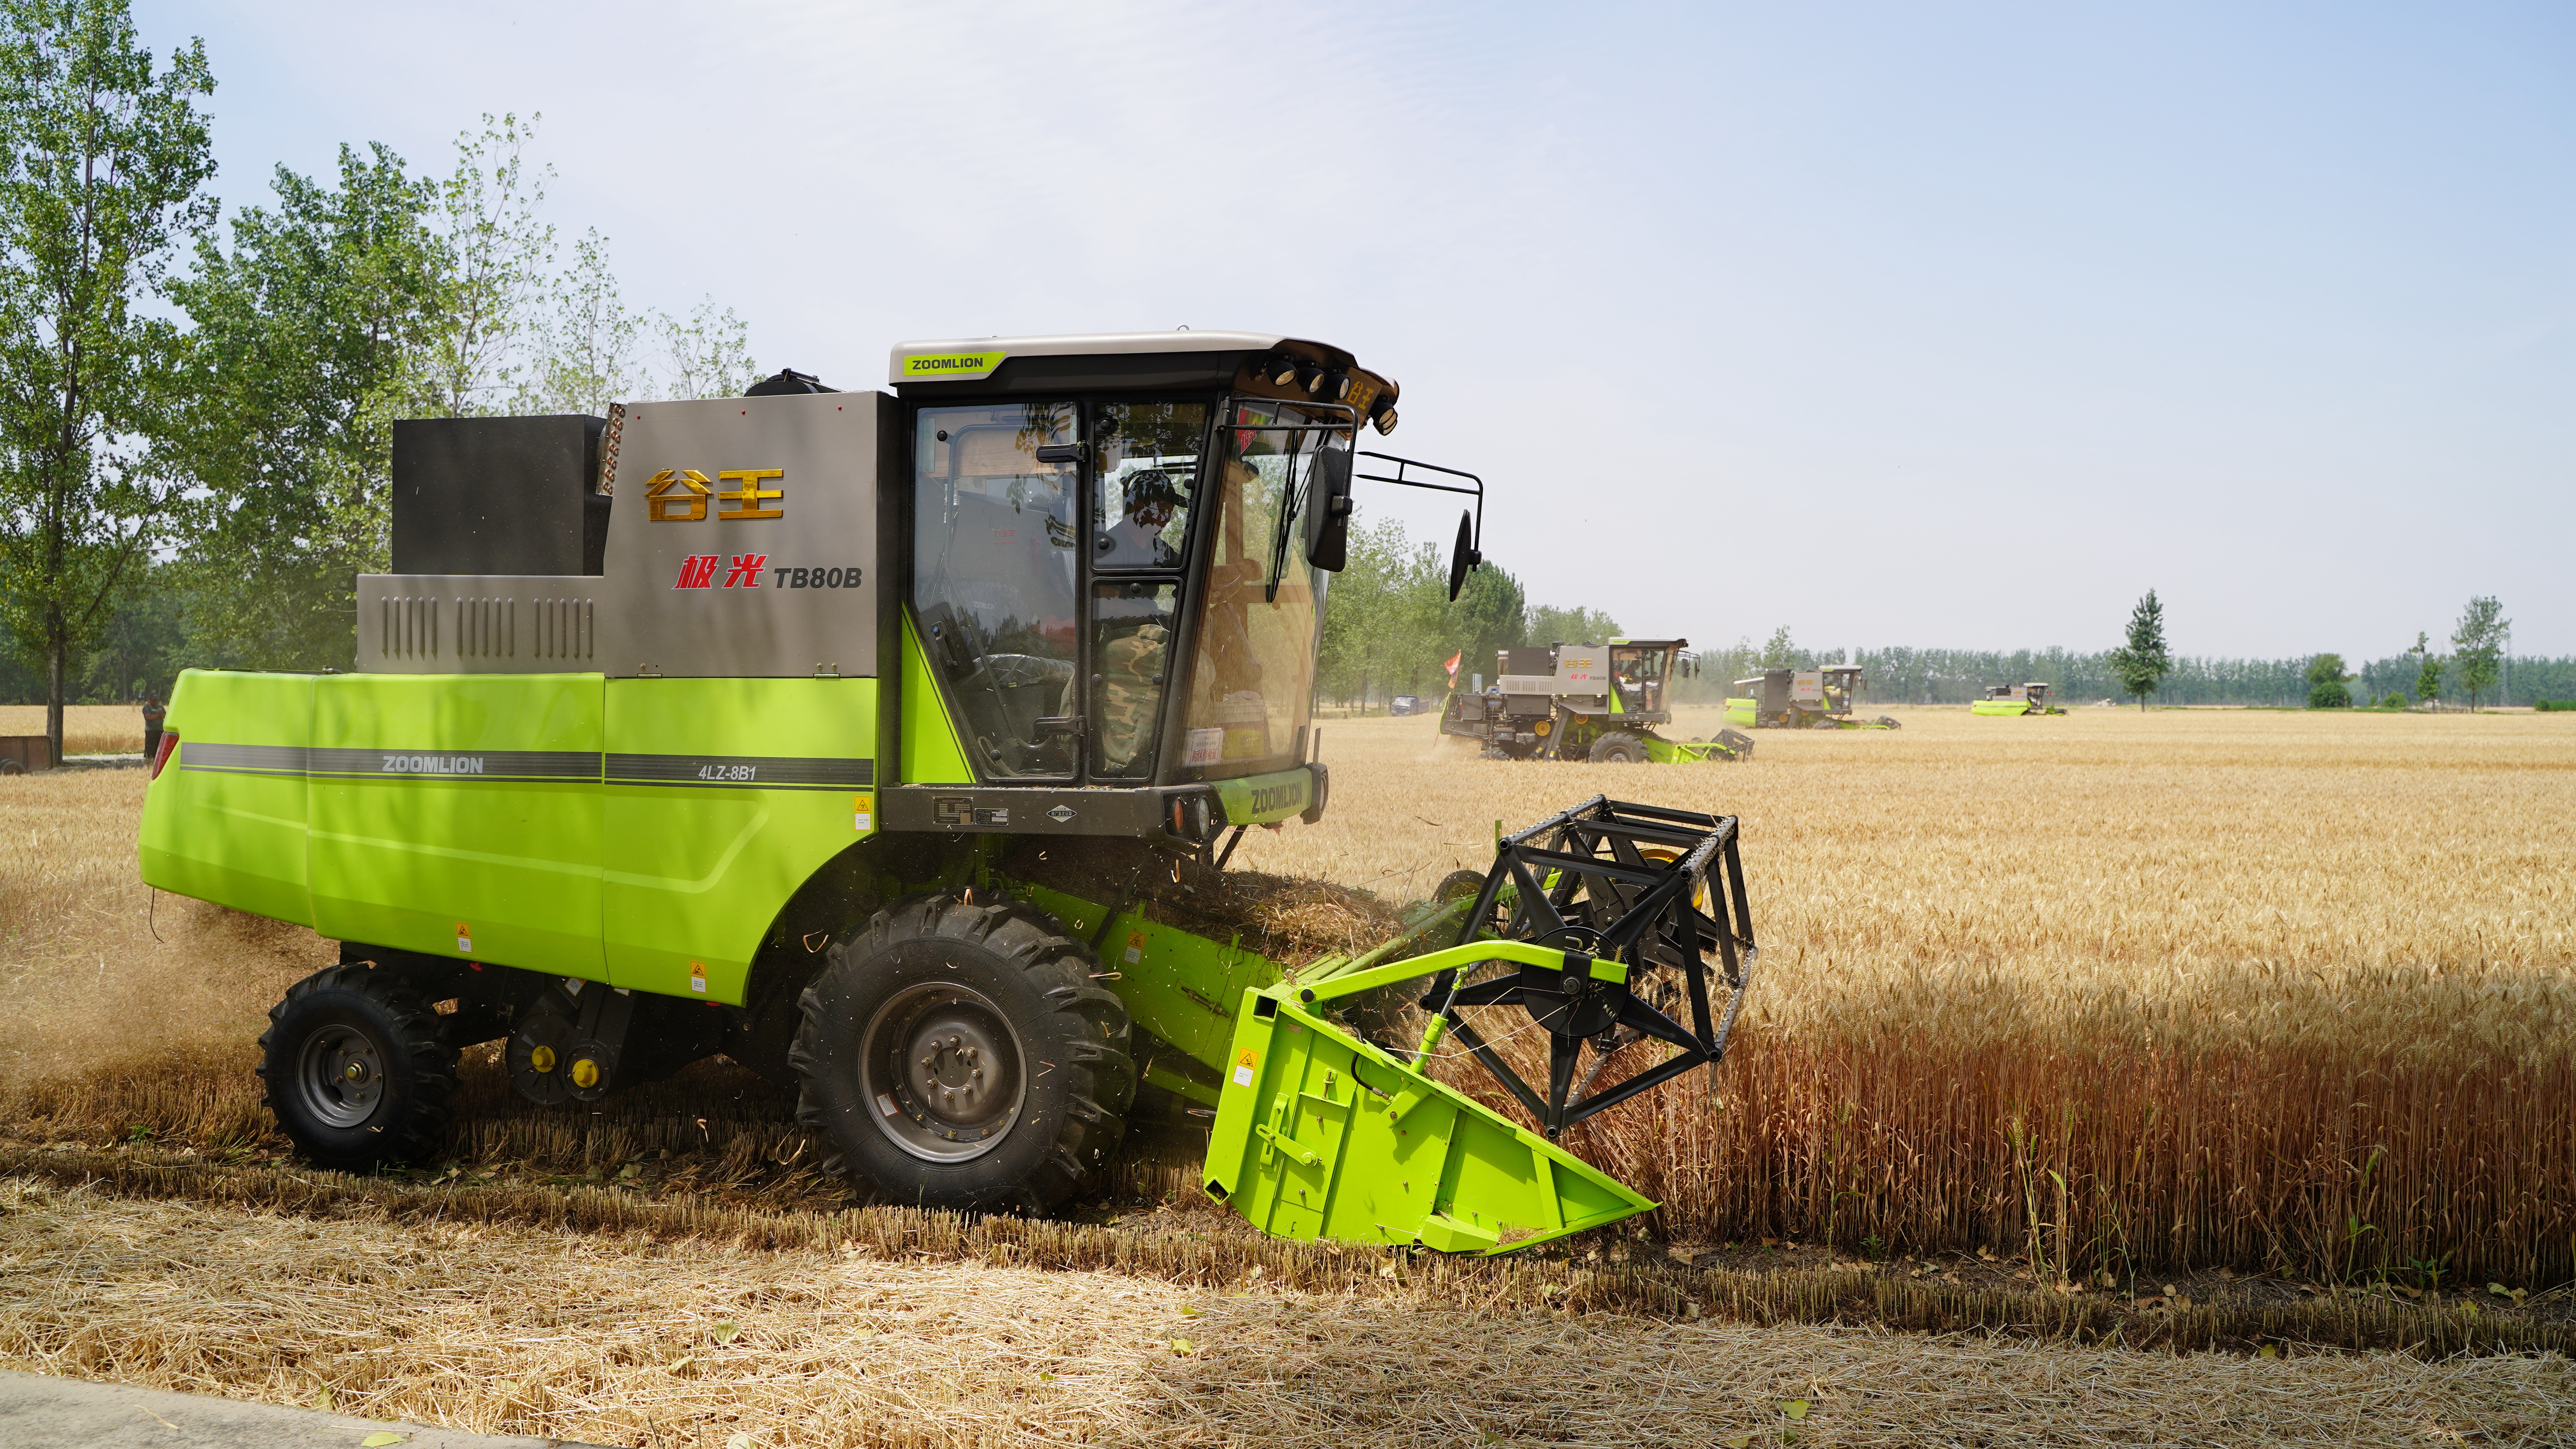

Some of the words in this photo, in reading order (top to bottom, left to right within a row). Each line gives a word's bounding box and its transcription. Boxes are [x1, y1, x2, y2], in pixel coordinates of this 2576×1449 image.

[912, 357, 983, 370] ZOOMLION
[1346, 381, 1374, 410] 谷王
[643, 469, 784, 521] 谷王
[671, 553, 769, 590] 极光
[774, 567, 862, 588] TB80B
[1564, 658, 1592, 668] 谷王
[382, 756, 483, 773] ZOOMLION
[698, 765, 756, 781] 4LZ-8B1
[1251, 782, 1302, 814] ZOOMLION
